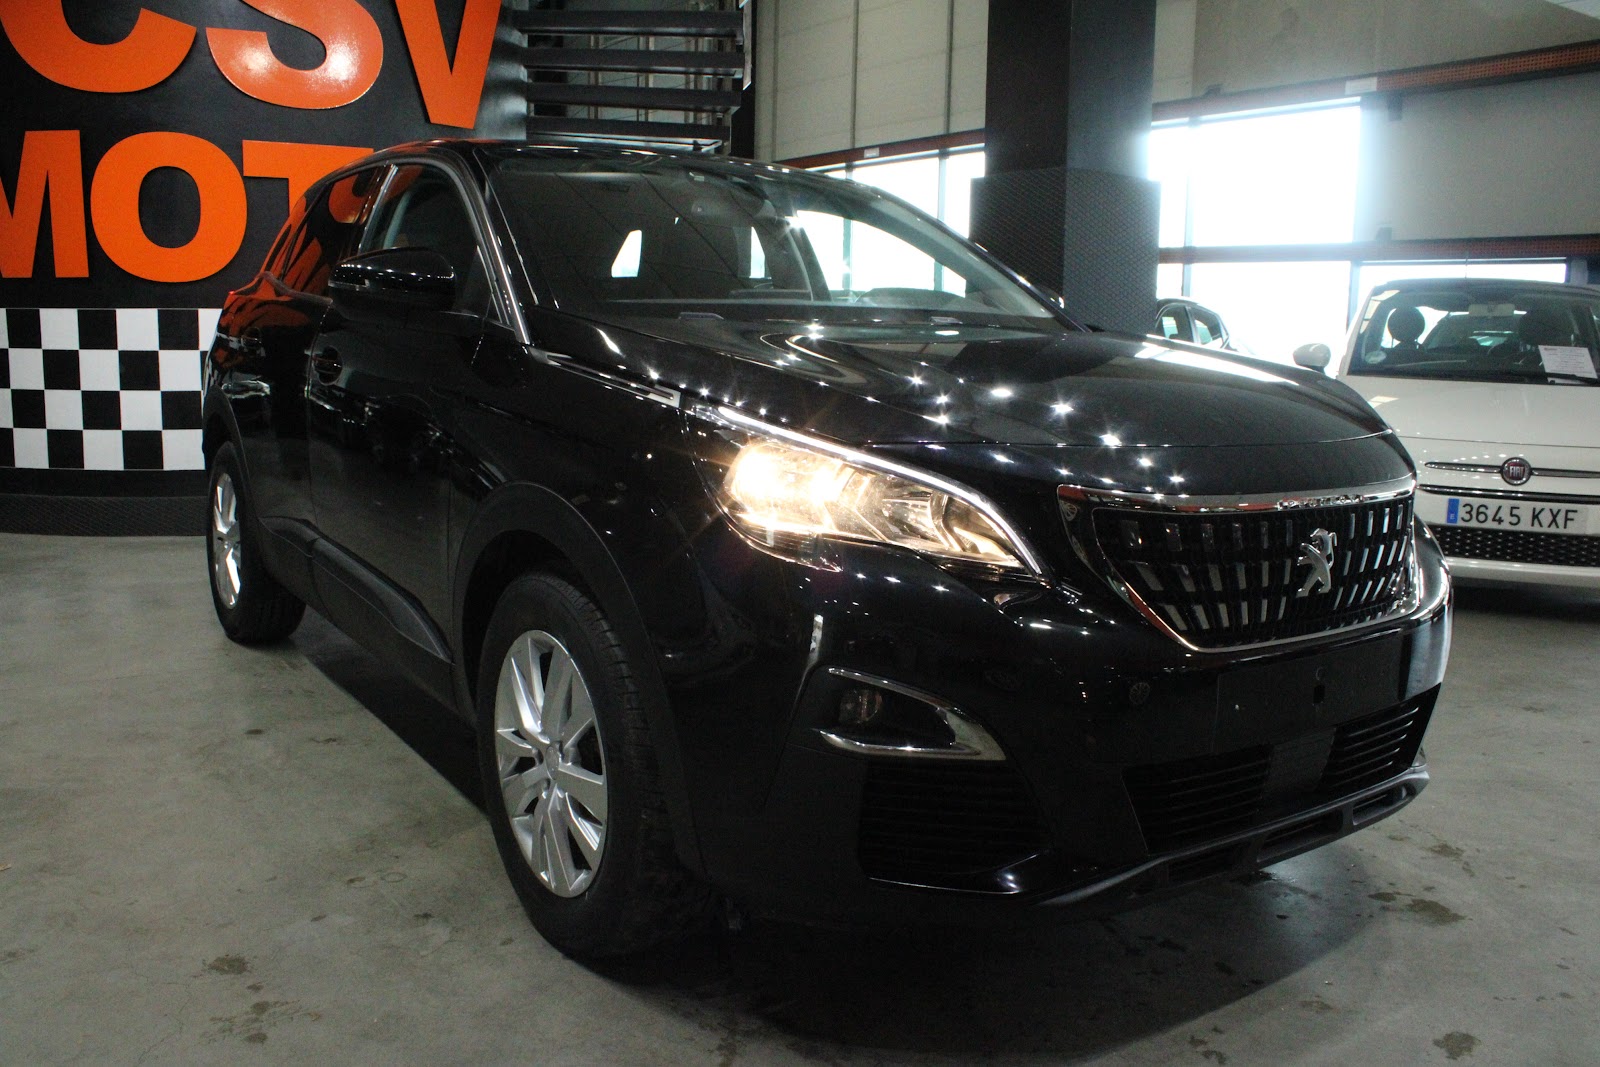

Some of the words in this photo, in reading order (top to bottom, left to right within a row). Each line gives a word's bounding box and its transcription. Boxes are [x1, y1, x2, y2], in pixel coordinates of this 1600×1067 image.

[1509, 465, 1525, 478] FIAT
[1460, 503, 1521, 526] 3645
[1530, 507, 1578, 529] KXF
